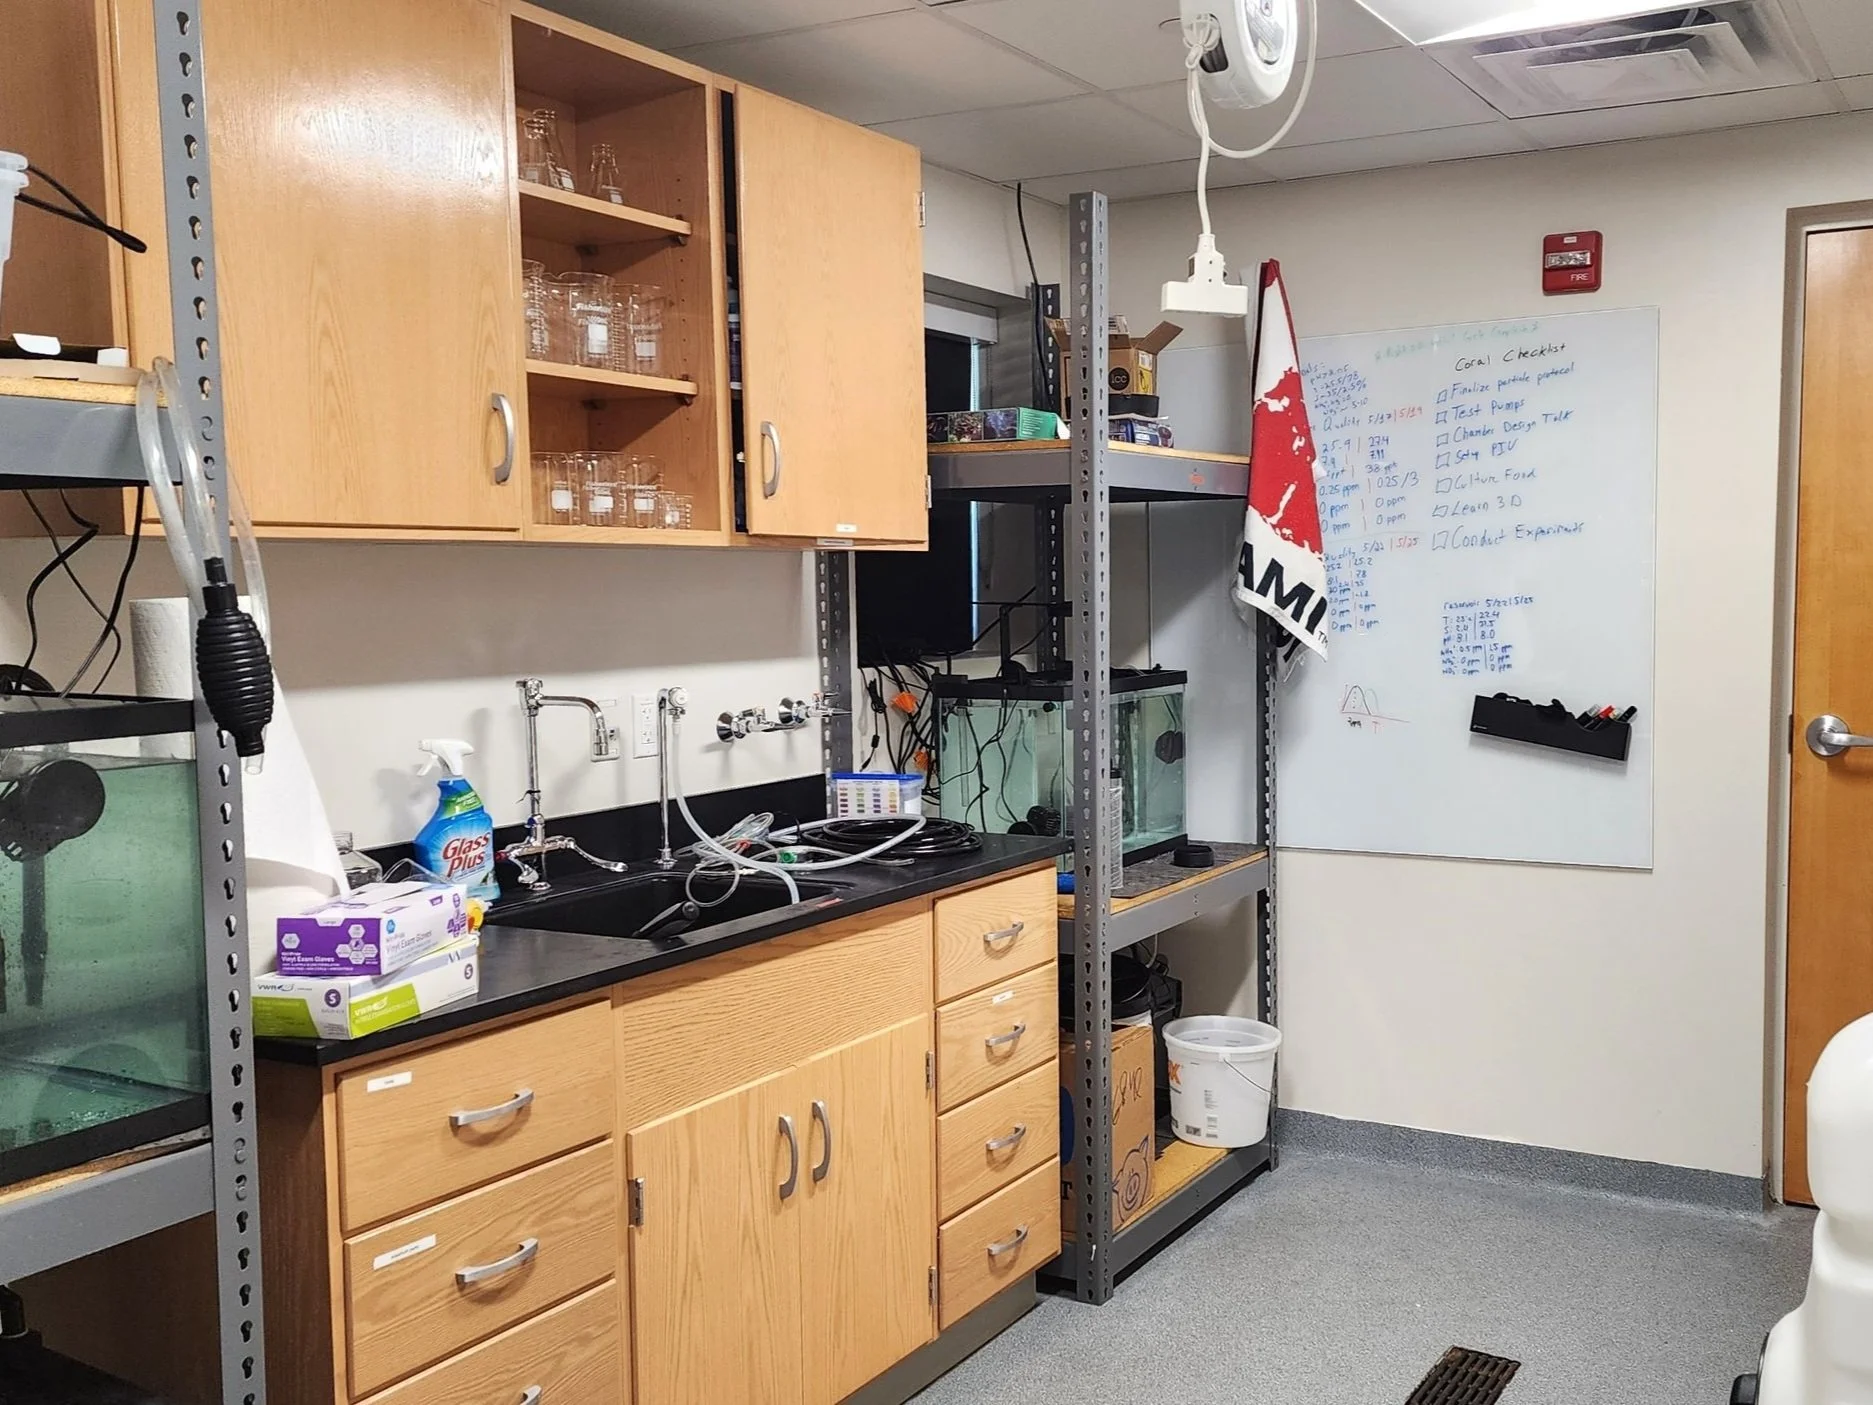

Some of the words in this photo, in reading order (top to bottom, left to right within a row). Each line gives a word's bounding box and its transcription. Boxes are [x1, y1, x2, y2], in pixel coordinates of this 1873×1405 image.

[1570, 273, 1590, 281] FIRE
[1455, 355, 1491, 372] Coral
[1503, 342, 1568, 362] Checklist
[1451, 382, 1490, 400] Finalize
[1537, 362, 1575, 386] protocol
[1452, 404, 1482, 421] Test
[1491, 398, 1526, 415] Pumps
[1503, 419, 1537, 433] Design
[1455, 474, 1499, 490] Culture
[1505, 468, 1537, 482] Food
[1342, 483, 1360, 498] ppm
[1330, 503, 1350, 518] ppm
[1387, 495, 1406, 508] ppm
[1451, 500, 1489, 517] Learn
[1333, 521, 1351, 535] ppm
[1387, 513, 1406, 526] ppm
[1451, 525, 1506, 550] Conduct
[442, 832, 491, 860] Glass
[446, 851, 486, 879] Plus
[328, 993, 336, 1005] S
